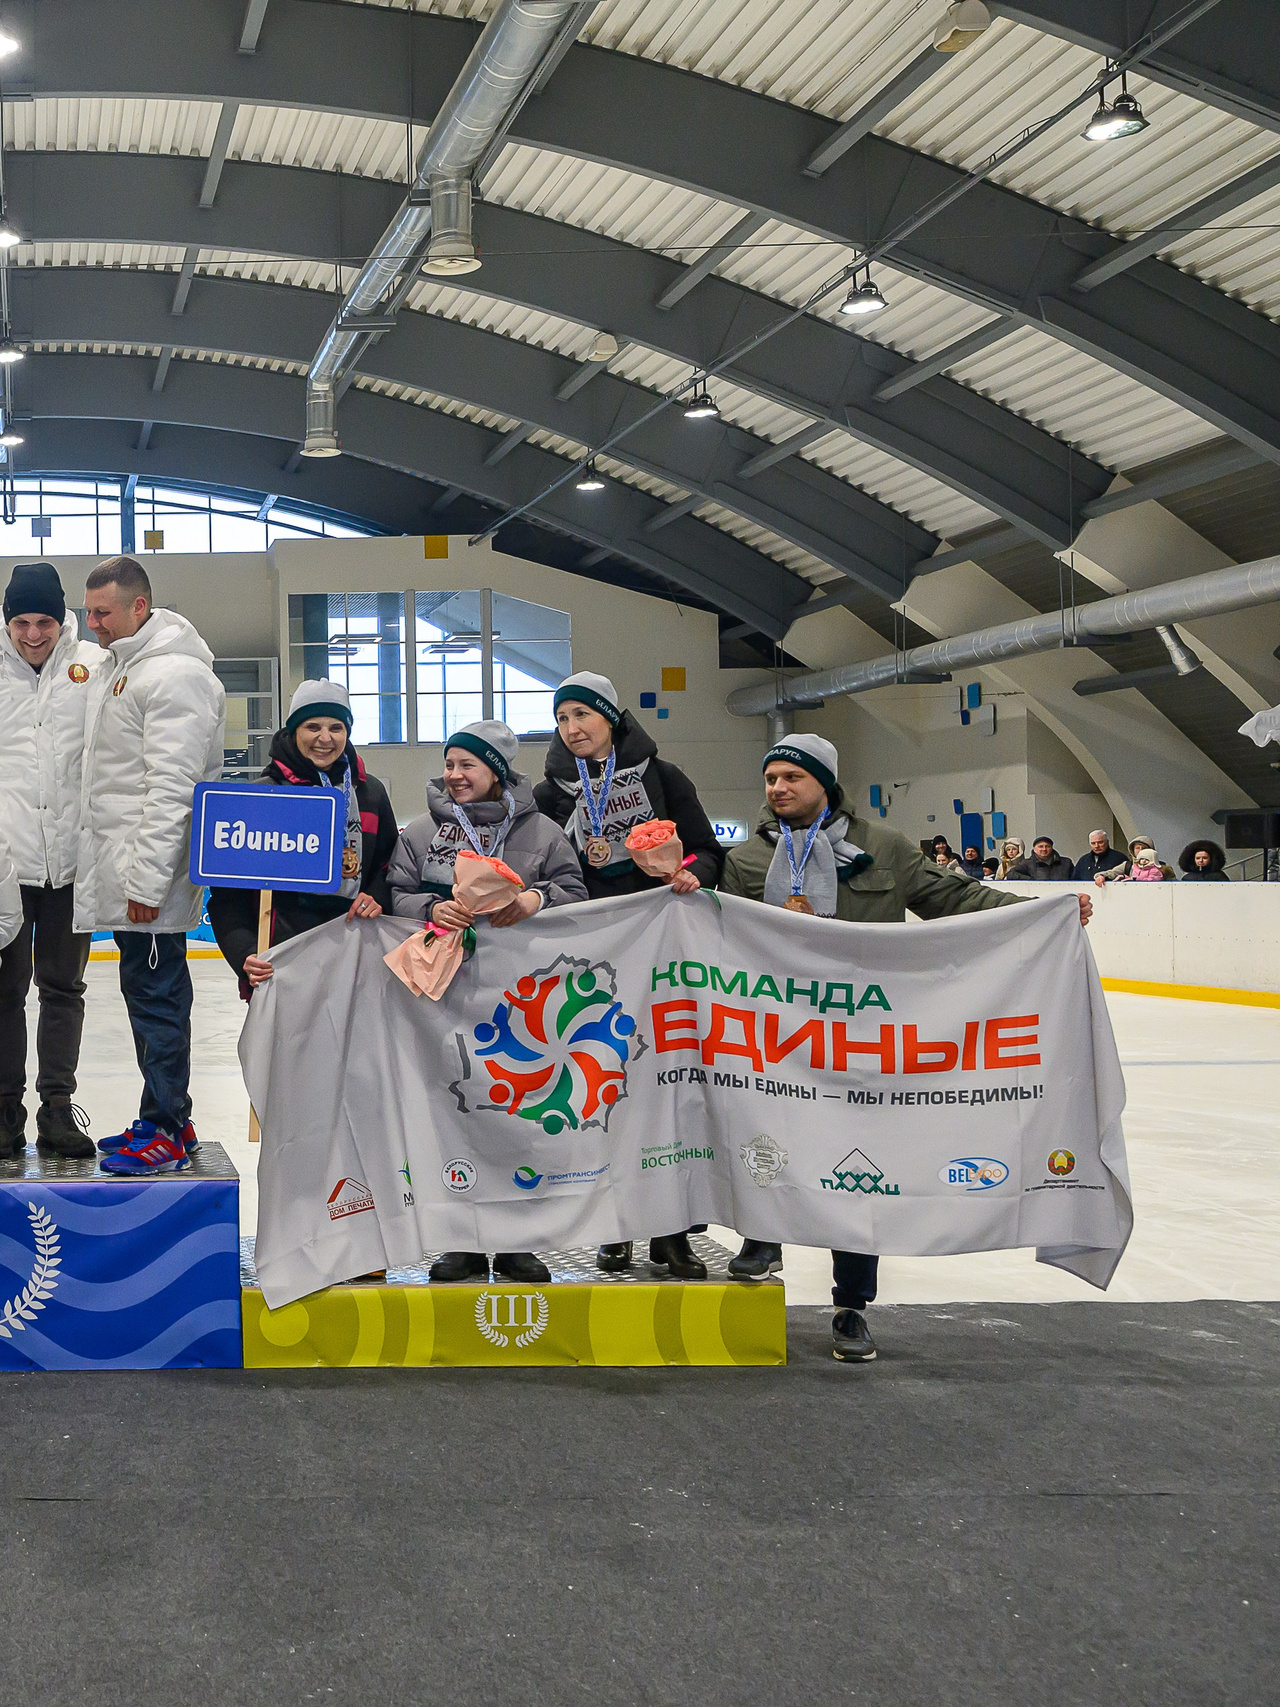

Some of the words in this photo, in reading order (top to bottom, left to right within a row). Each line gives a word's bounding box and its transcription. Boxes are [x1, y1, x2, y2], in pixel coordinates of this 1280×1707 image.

[764, 749, 802, 760] АРУСЬ
[582, 791, 643, 820] ИНЫЕ
[214, 820, 320, 854] Единые
[439, 825, 490, 848] ЕДИЕ
[651, 960, 893, 1016] КОМАНДА
[651, 999, 1041, 1075] ЕДИНЫЕ
[657, 1067, 708, 1086] КОГДА
[713, 1072, 749, 1089] МЫ
[755, 1077, 817, 1101] ЕДИНЫ
[847, 1090, 883, 1105] МЫ
[890, 1084, 1044, 1106] НЕПОБЕДИМЫ!
[641, 1147, 715, 1170] ВОСТОЧНЫЙ
[329, 1206, 346, 1217] ДОМ
[348, 1199, 374, 1211] ПЕЧАТИ
